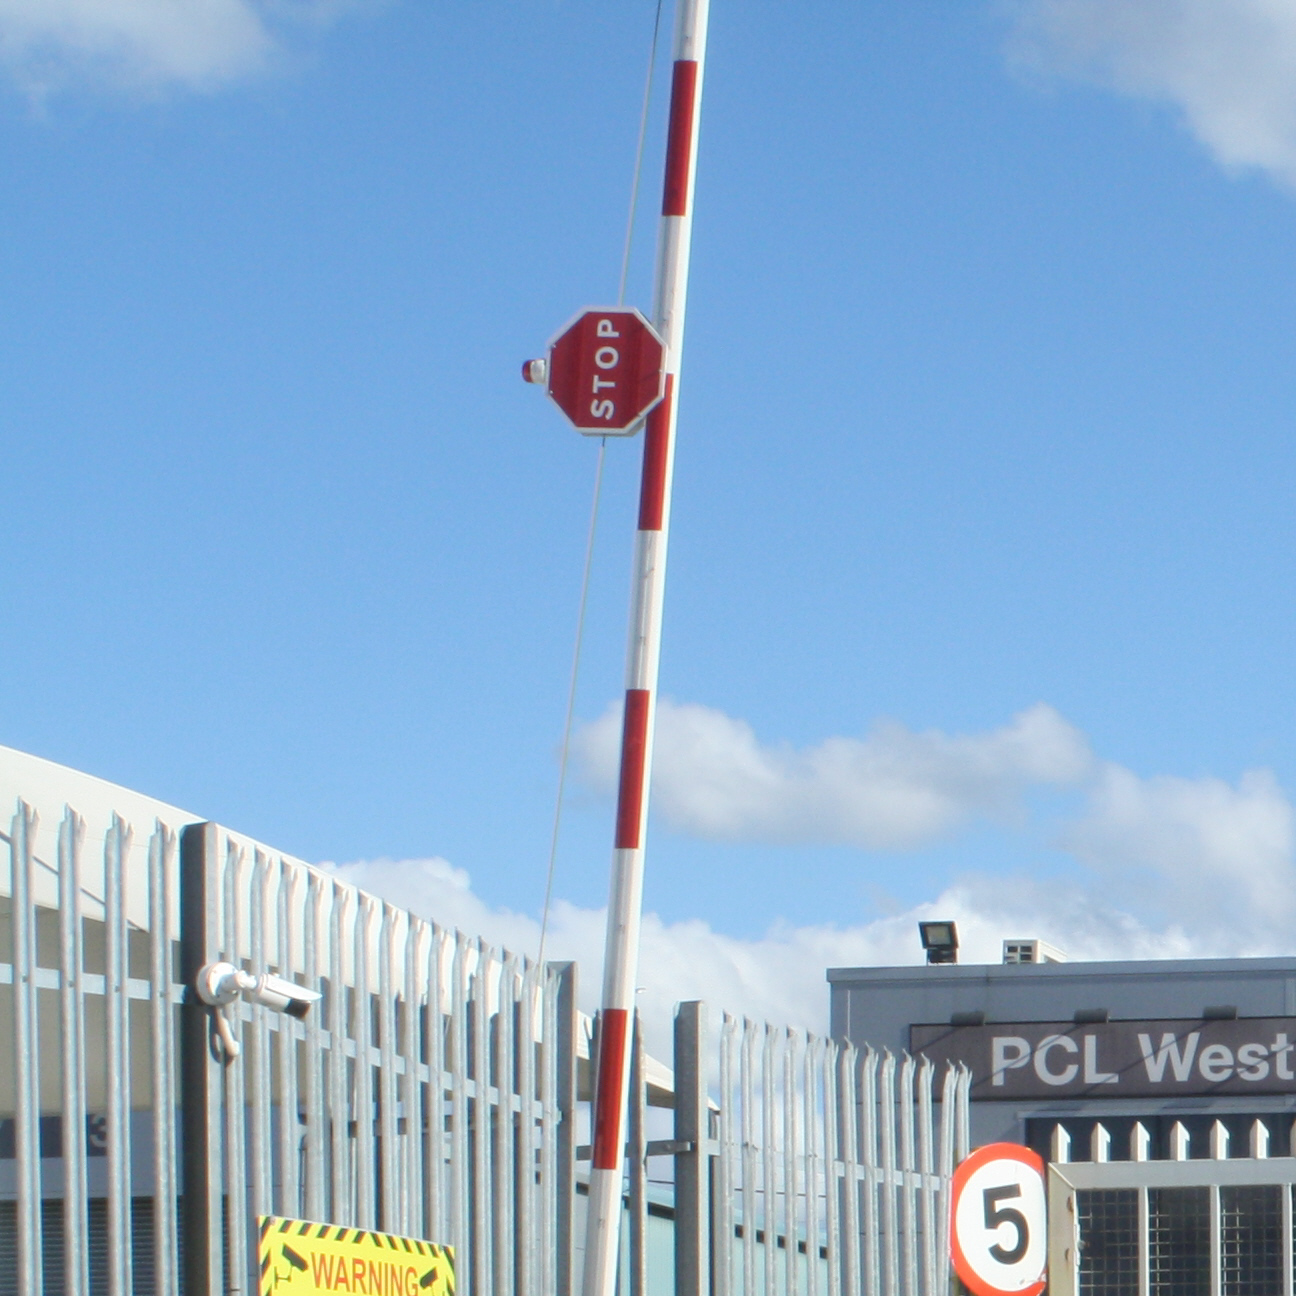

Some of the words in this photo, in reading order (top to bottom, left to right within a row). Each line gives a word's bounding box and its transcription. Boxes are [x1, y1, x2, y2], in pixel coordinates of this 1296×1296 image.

[590, 319, 620, 420] STOP
[991, 1034, 1119, 1086] PCL
[1137, 1031, 1295, 1082] West
[982, 1183, 1030, 1266] 5
